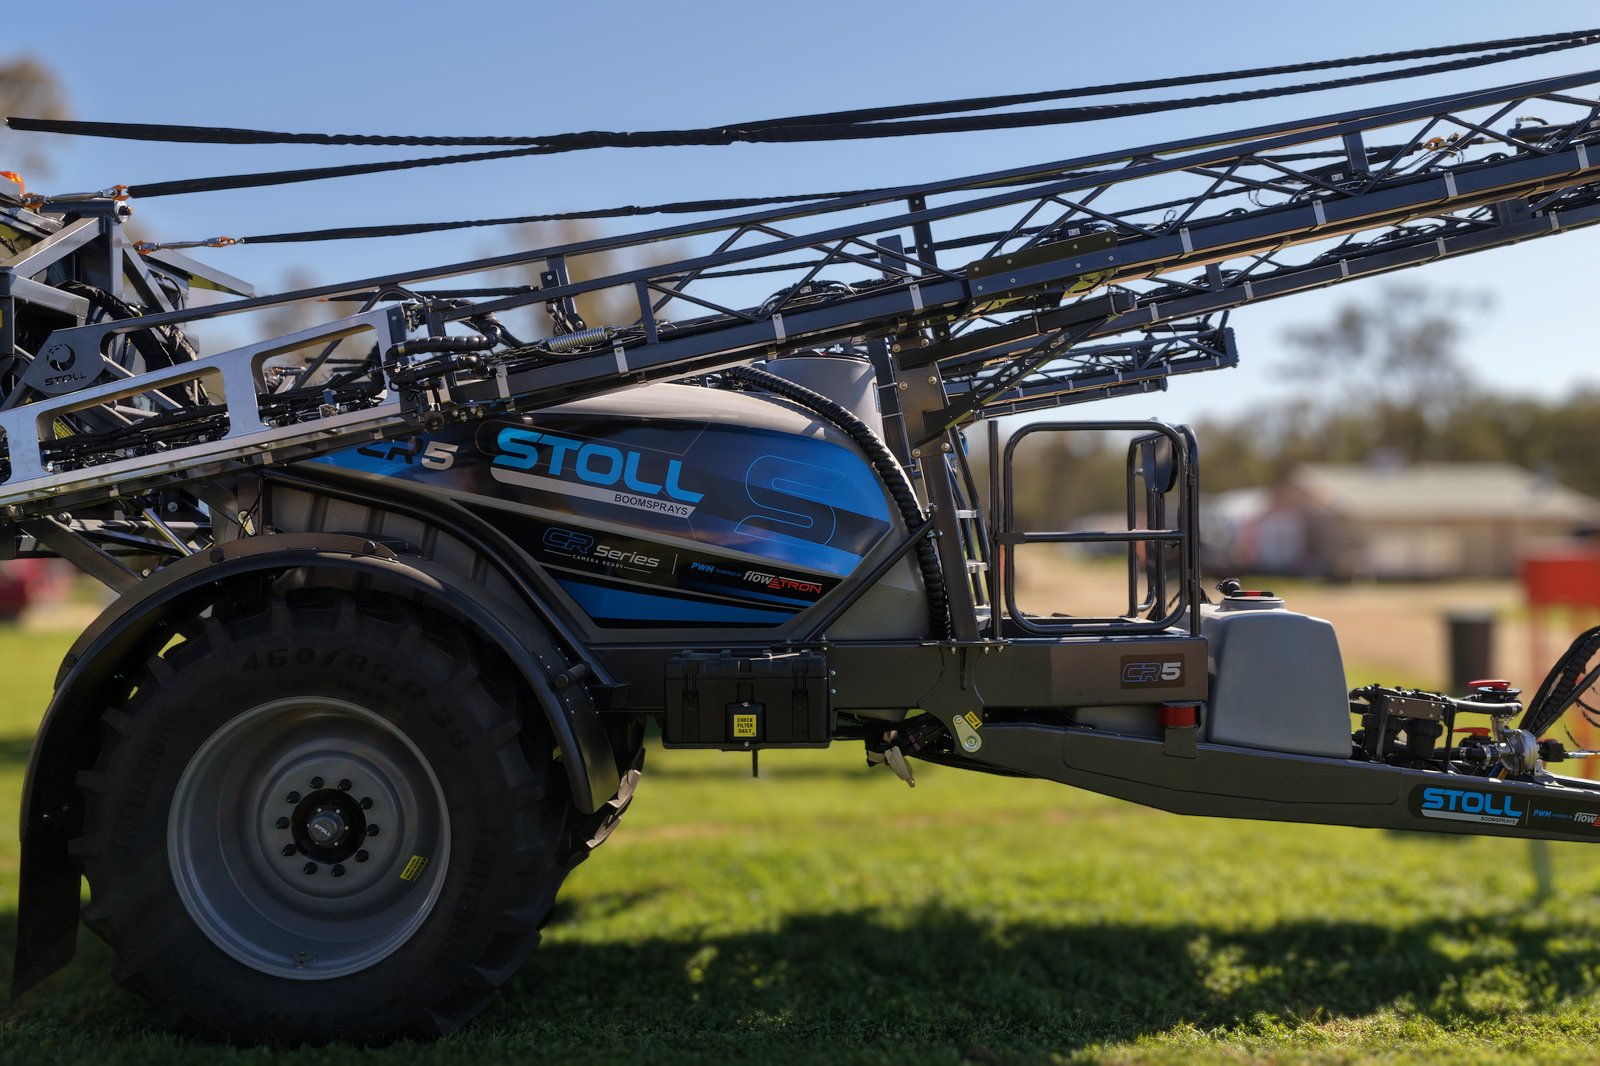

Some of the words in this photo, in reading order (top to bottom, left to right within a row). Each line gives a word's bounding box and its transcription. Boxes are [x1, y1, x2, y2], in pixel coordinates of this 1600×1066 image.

[45, 372, 87, 386] STOLL
[492, 427, 705, 504] STOLL
[614, 493, 688, 516] BOOMSPRAYS
[543, 527, 595, 555] CR
[593, 544, 660, 568] Series
[572, 554, 599, 564] CAMERA
[602, 560, 624, 569] READY
[690, 562, 715, 573] PWM
[1122, 662, 1181, 682] CR5
[1422, 788, 1523, 817] STOLL
[1480, 815, 1517, 825] BOOMSPRAYS
[1533, 809, 1552, 818] PWM
[313, 823, 332, 837] STOLL
